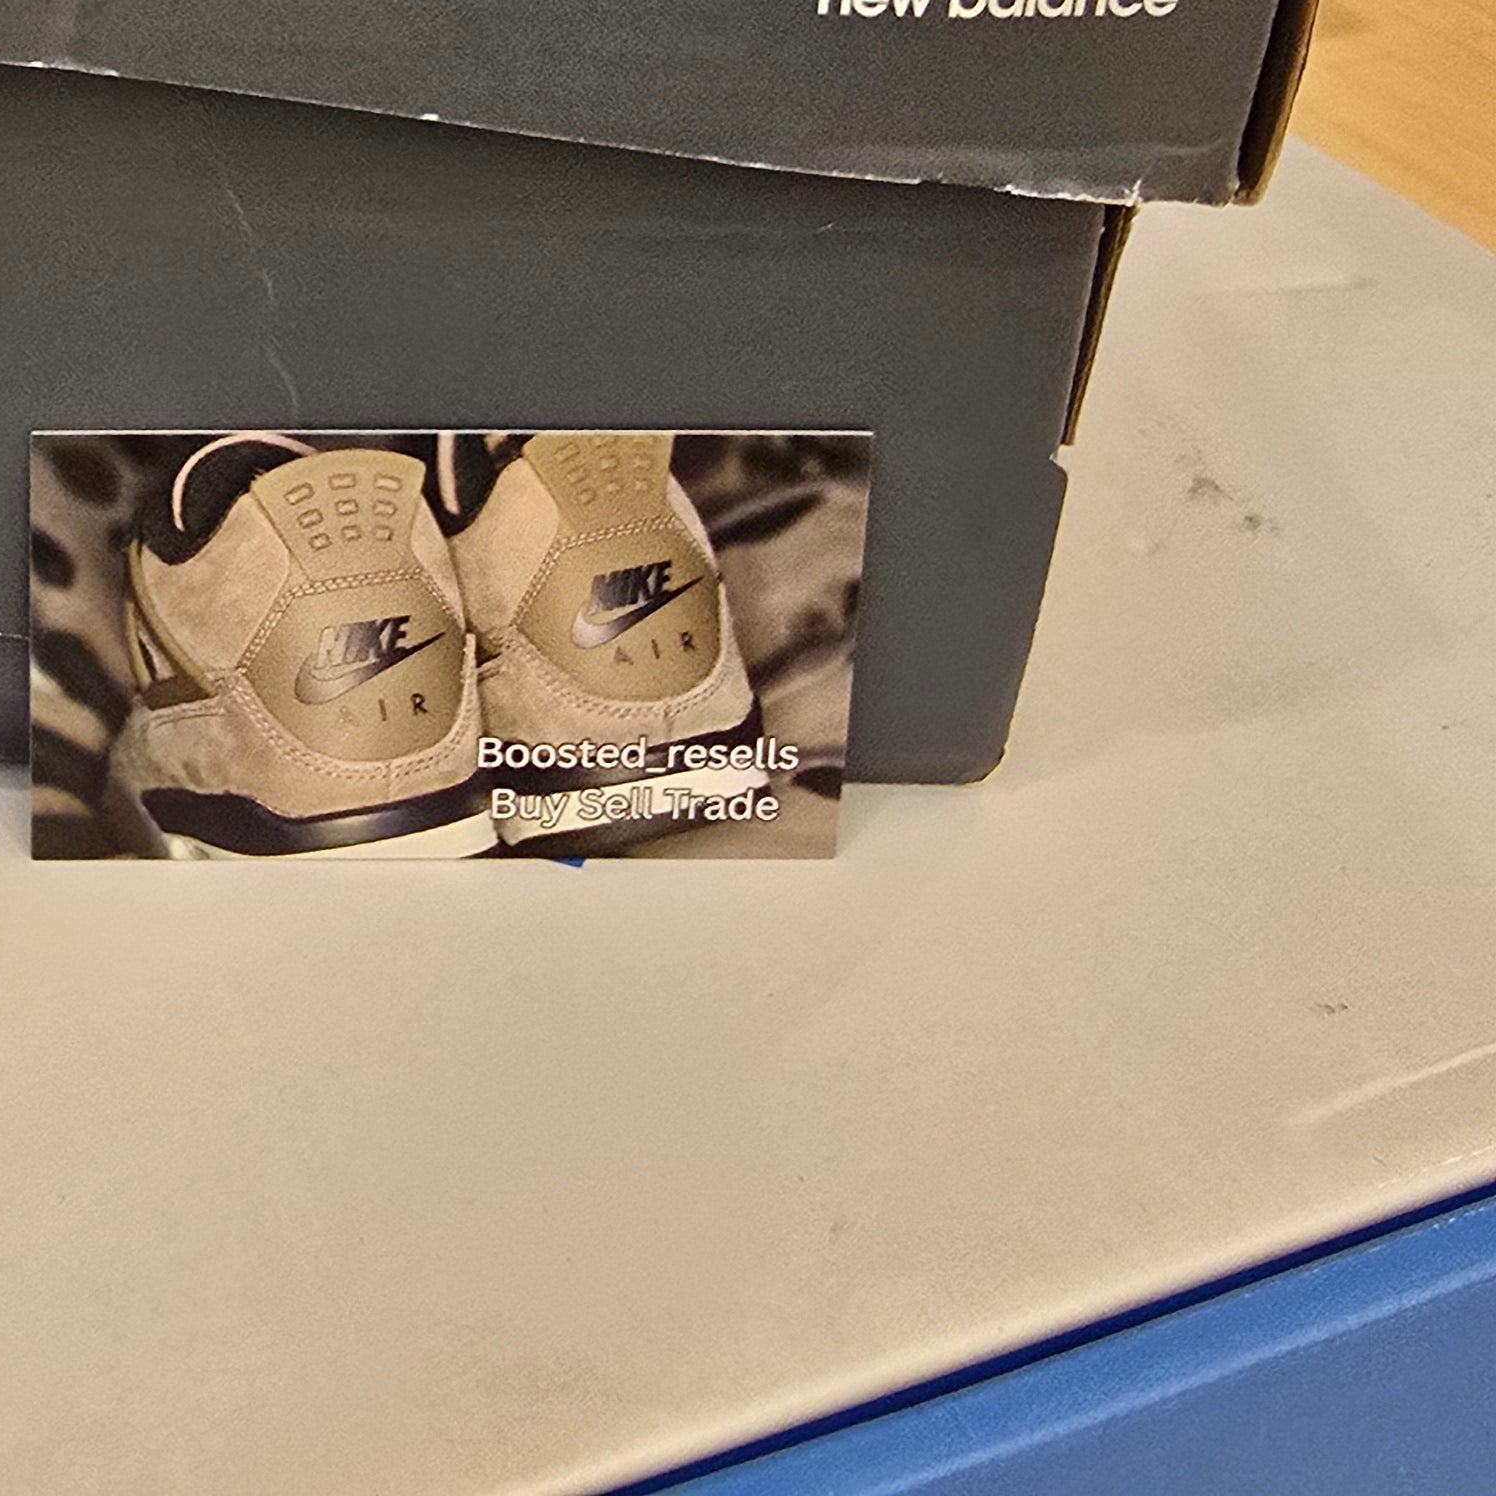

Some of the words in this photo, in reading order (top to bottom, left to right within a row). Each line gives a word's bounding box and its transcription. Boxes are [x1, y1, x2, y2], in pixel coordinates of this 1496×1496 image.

[586, 560, 672, 617] NIKE
[314, 615, 411, 670] NIKE
[477, 736, 800, 774] Boosted_resells
[490, 787, 568, 829] Buy
[577, 787, 653, 821] Sell
[664, 788, 780, 822] Trade
